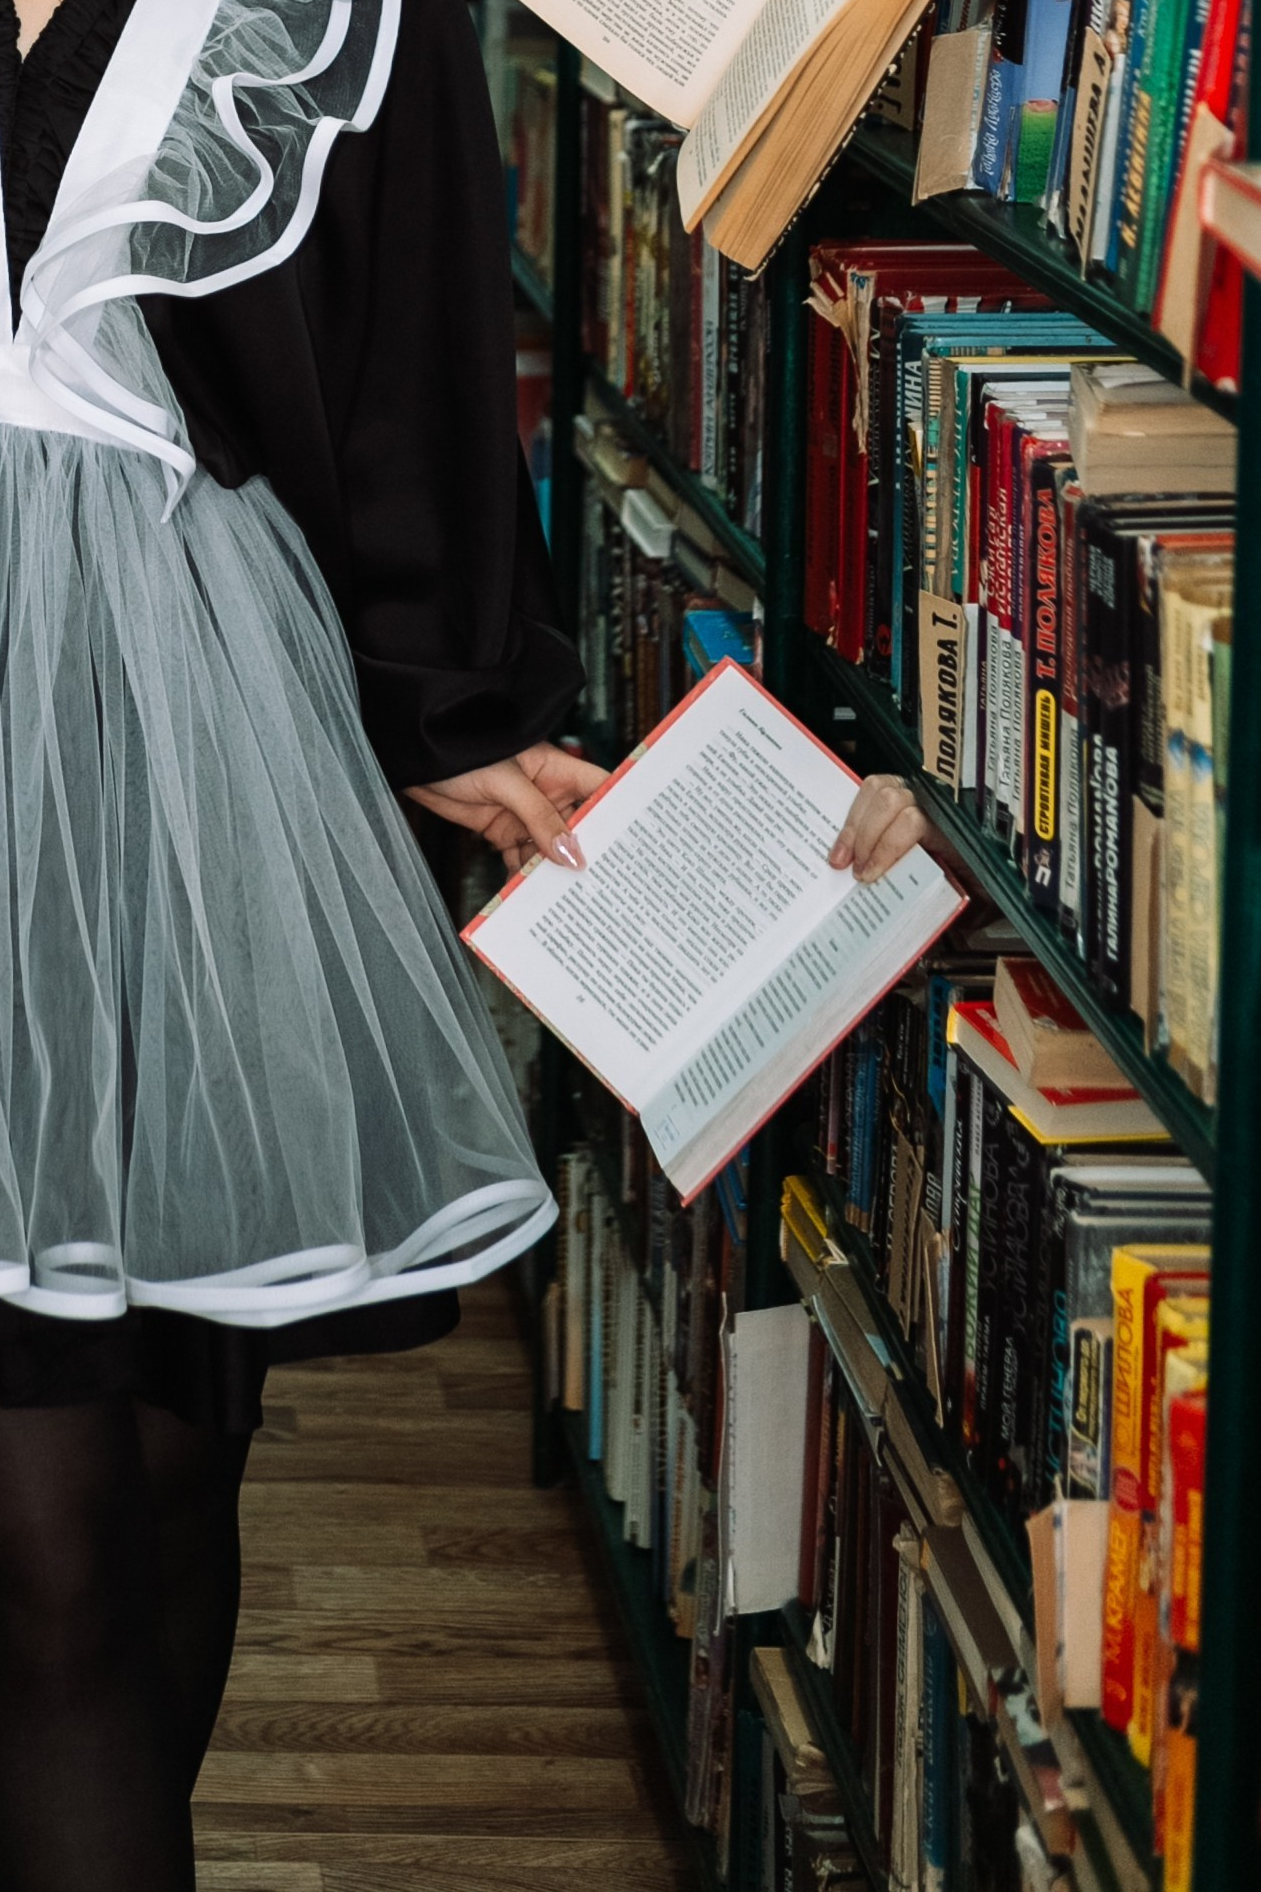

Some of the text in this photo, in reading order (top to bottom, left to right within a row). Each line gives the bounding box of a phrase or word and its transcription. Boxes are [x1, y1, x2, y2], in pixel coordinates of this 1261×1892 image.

[1036, 487, 1058, 680] Т. ПОЛЯКОВА
[931, 611, 959, 780] ПОЛЯКОВА Т.
[979, 660, 988, 711] ТАТЬЯНА
[986, 624, 999, 772] Татьяна Полякова
[998, 640, 1013, 787] Татьяна Полякова
[1038, 695, 1052, 836] СТРОПТИВАЯ МИШЕНЬ
[1114, 1287, 1135, 1419] ШИЛОВА
